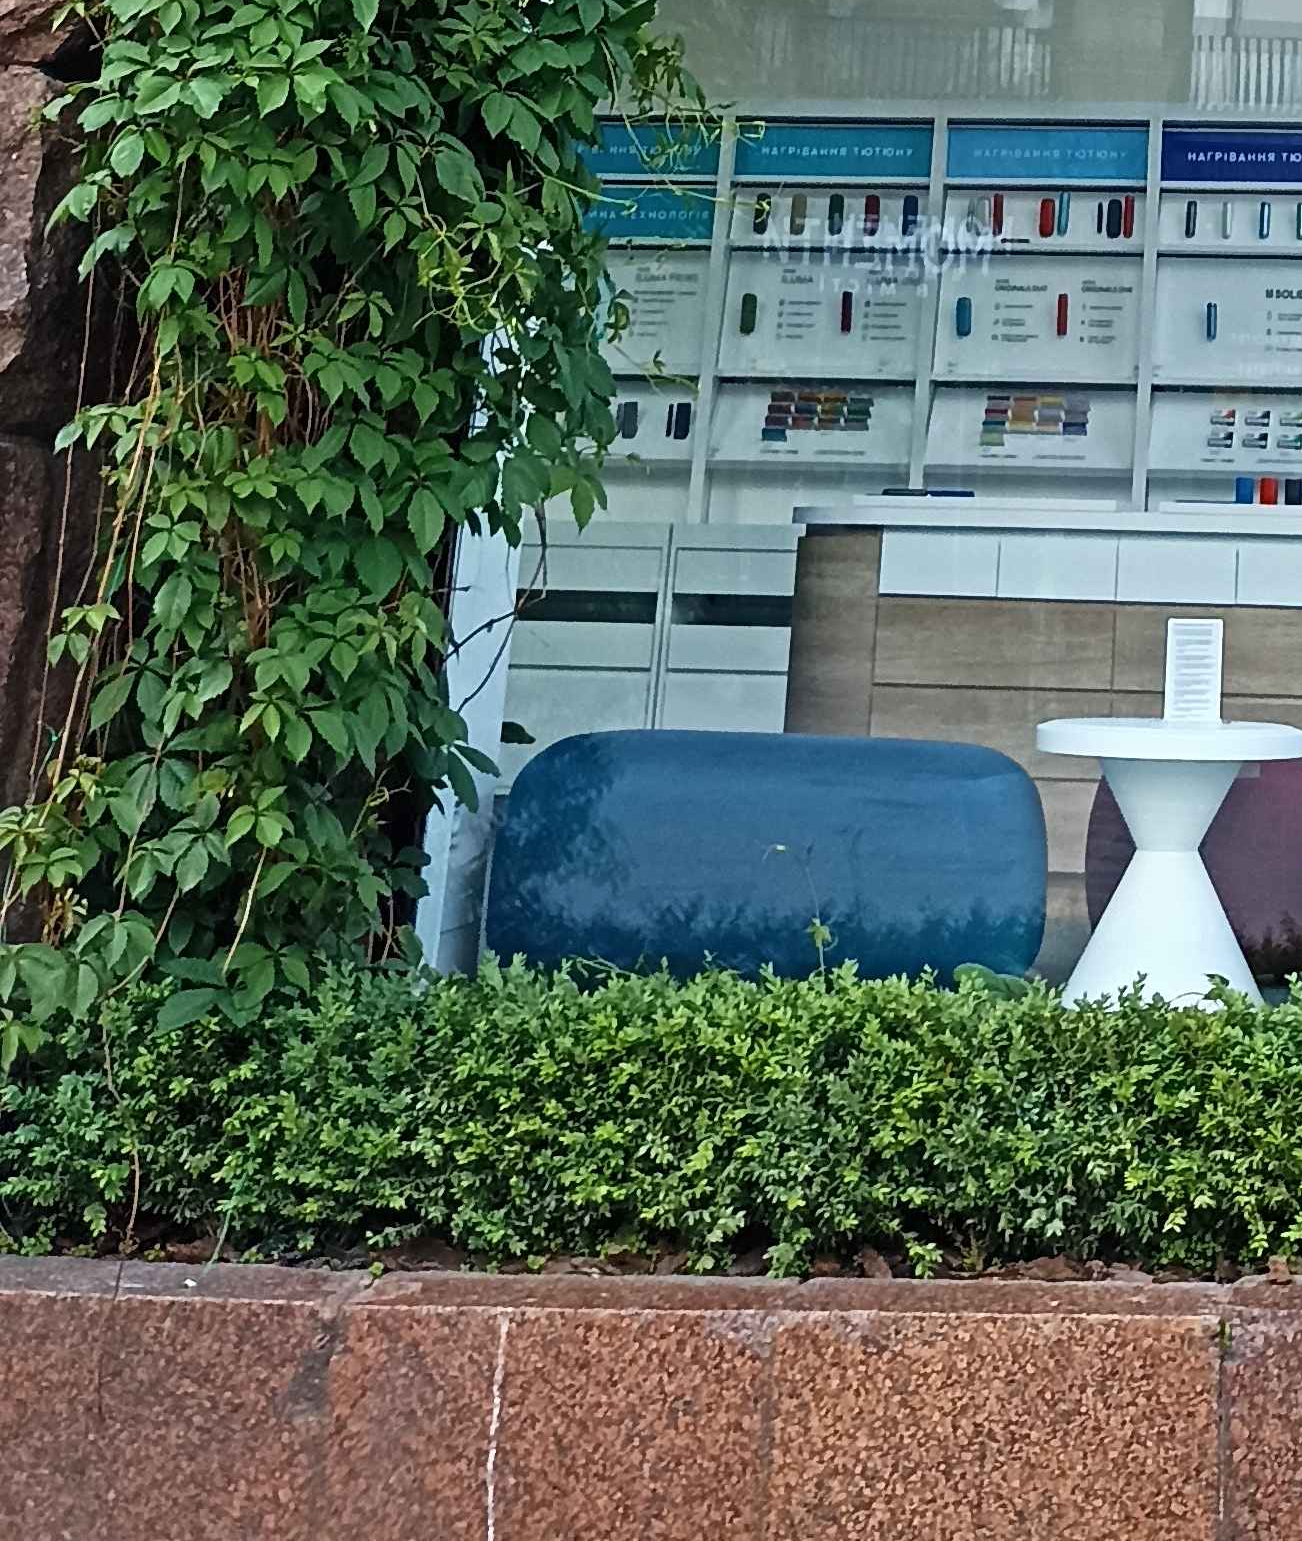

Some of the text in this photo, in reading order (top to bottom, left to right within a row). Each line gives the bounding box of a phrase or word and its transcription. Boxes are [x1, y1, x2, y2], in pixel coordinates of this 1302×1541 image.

[761, 146, 914, 158] НАГРІВАННЯ ТЮТЮНУ
[1187, 151, 1276, 163] НАГРІВАННЯ
